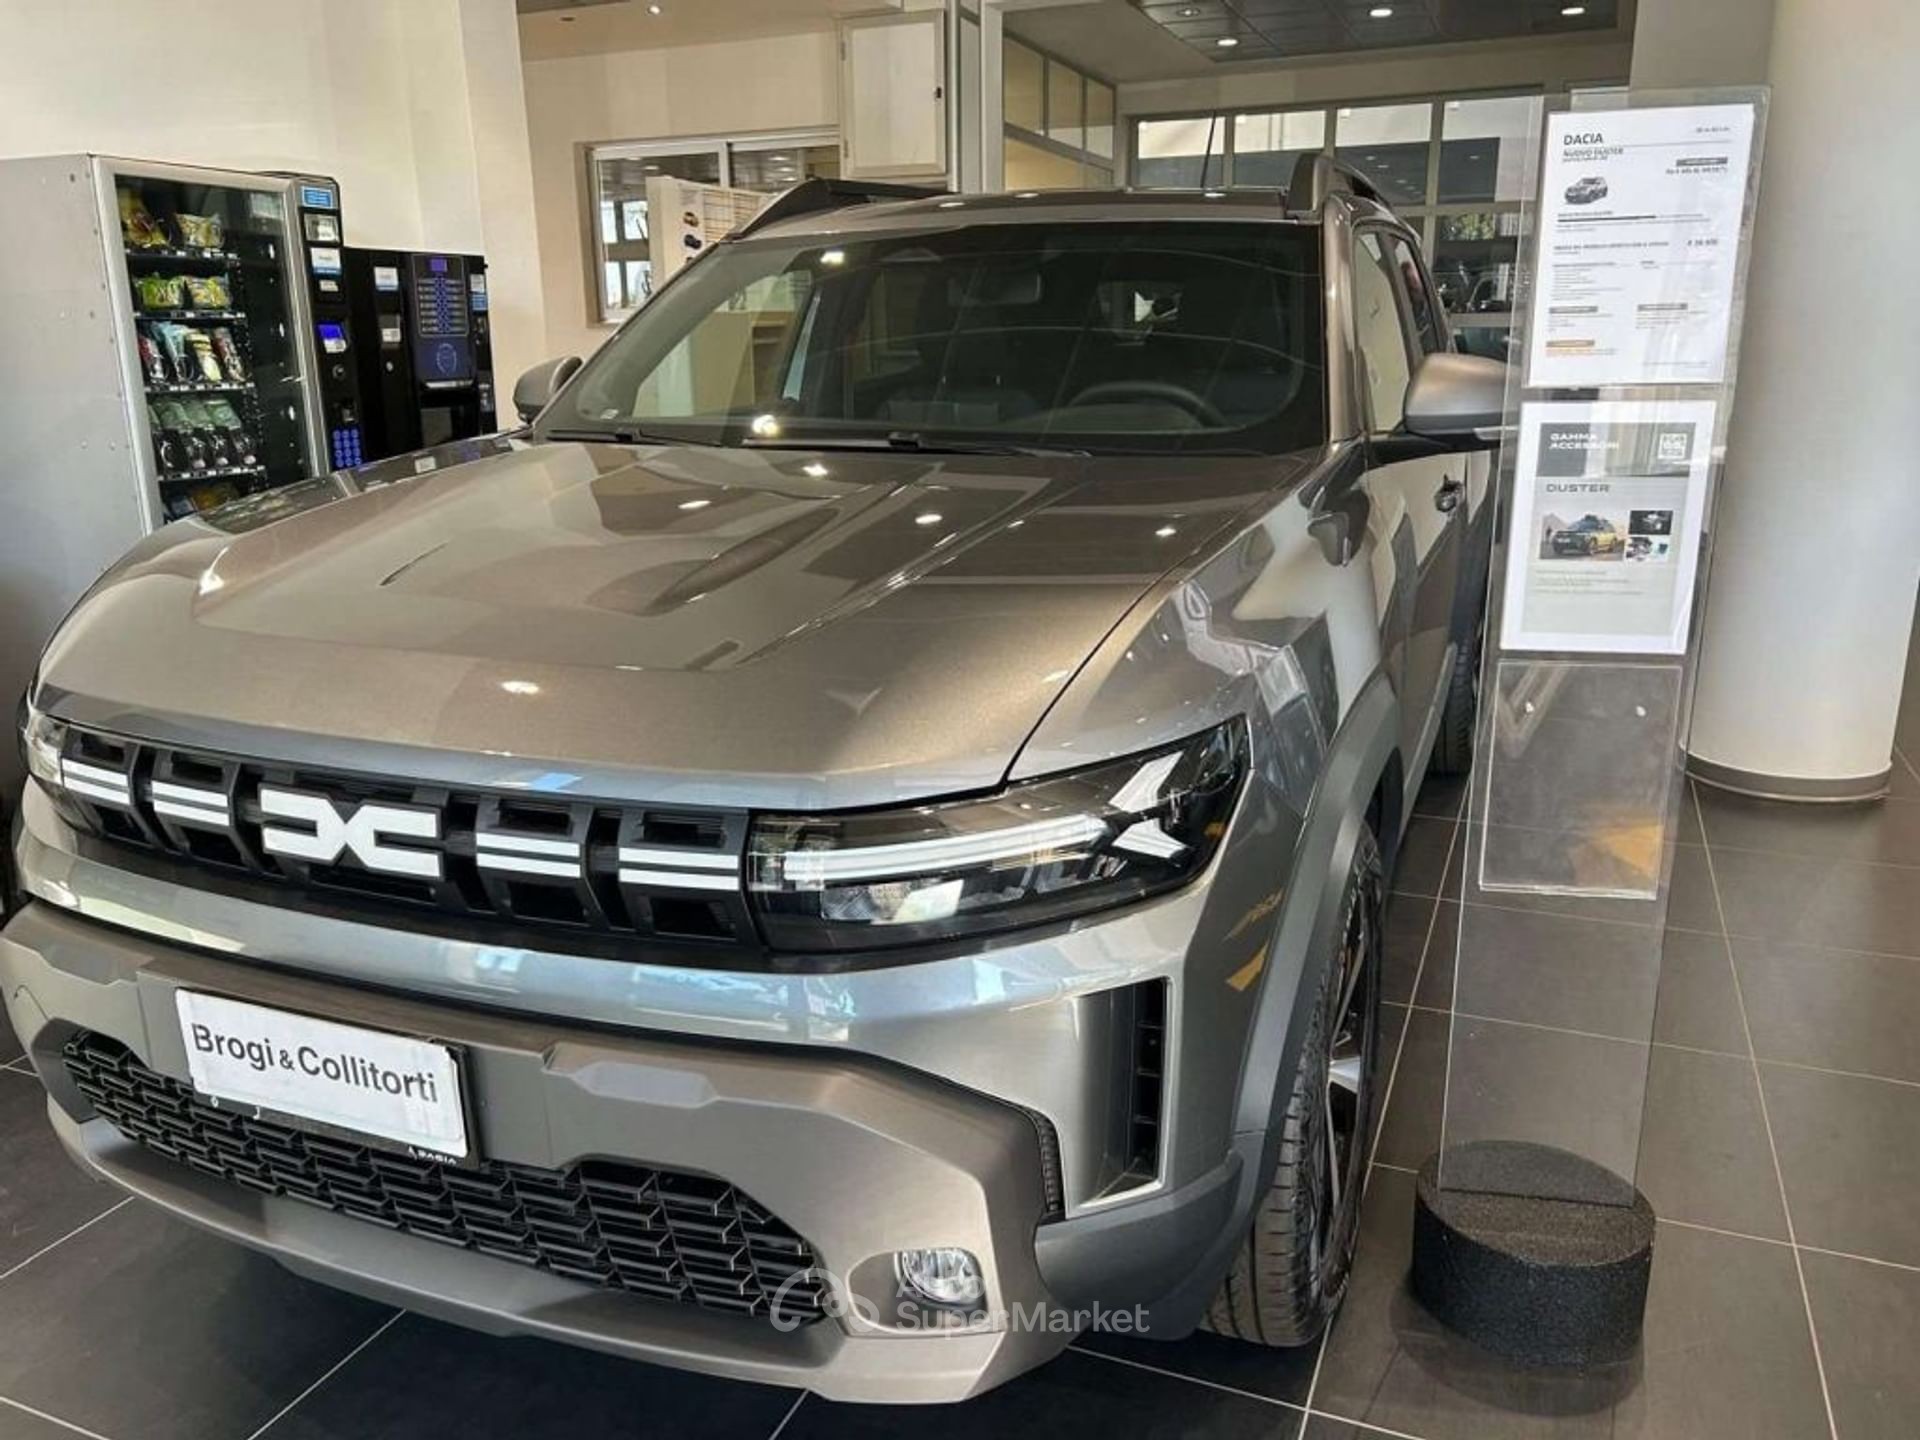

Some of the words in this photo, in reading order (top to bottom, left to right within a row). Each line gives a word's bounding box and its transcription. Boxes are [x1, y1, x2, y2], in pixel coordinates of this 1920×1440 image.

[1563, 133, 1604, 146] DACIA
[1550, 433, 1598, 441] GAMMA
[1546, 483, 1611, 493] DUSTER
